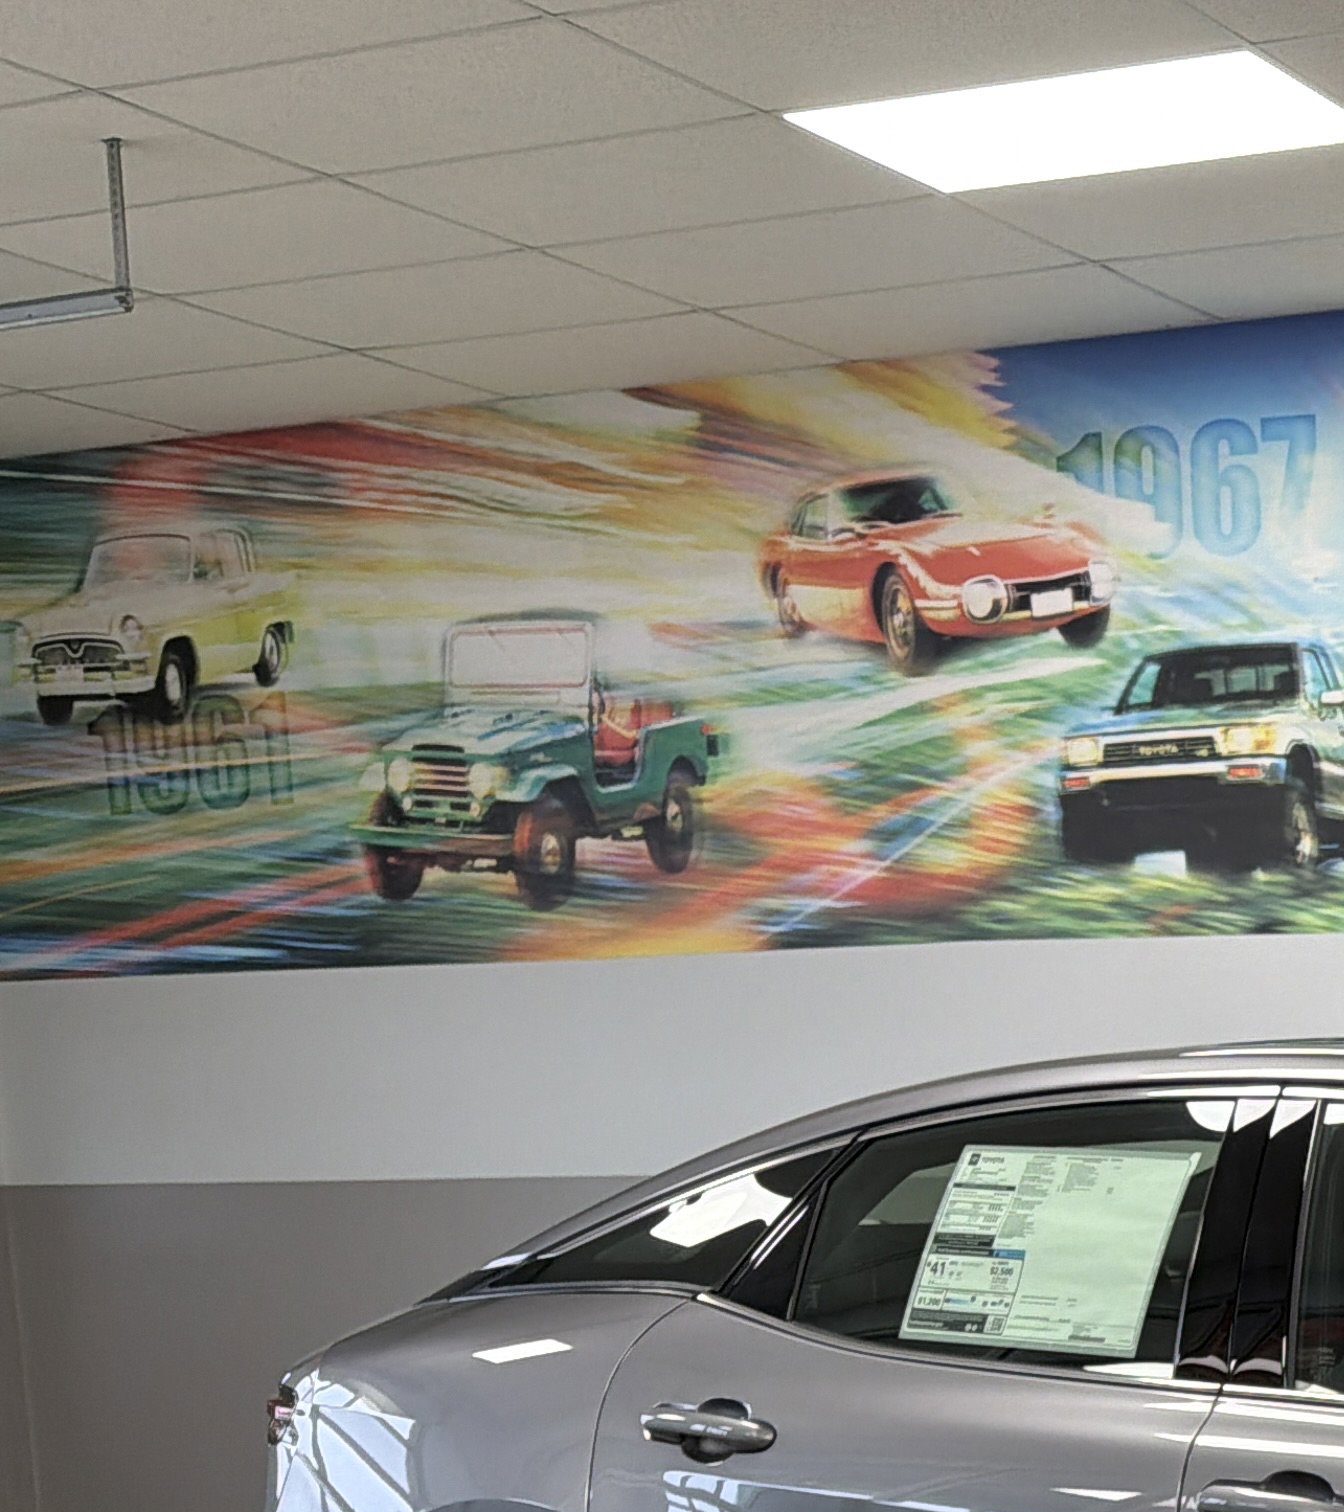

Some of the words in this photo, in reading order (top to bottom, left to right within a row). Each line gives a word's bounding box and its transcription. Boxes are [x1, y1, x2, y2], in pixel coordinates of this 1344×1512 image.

[1056, 413, 1317, 560] 1967
[87, 690, 296, 817] 1961
[930, 1261, 947, 1277] 41
